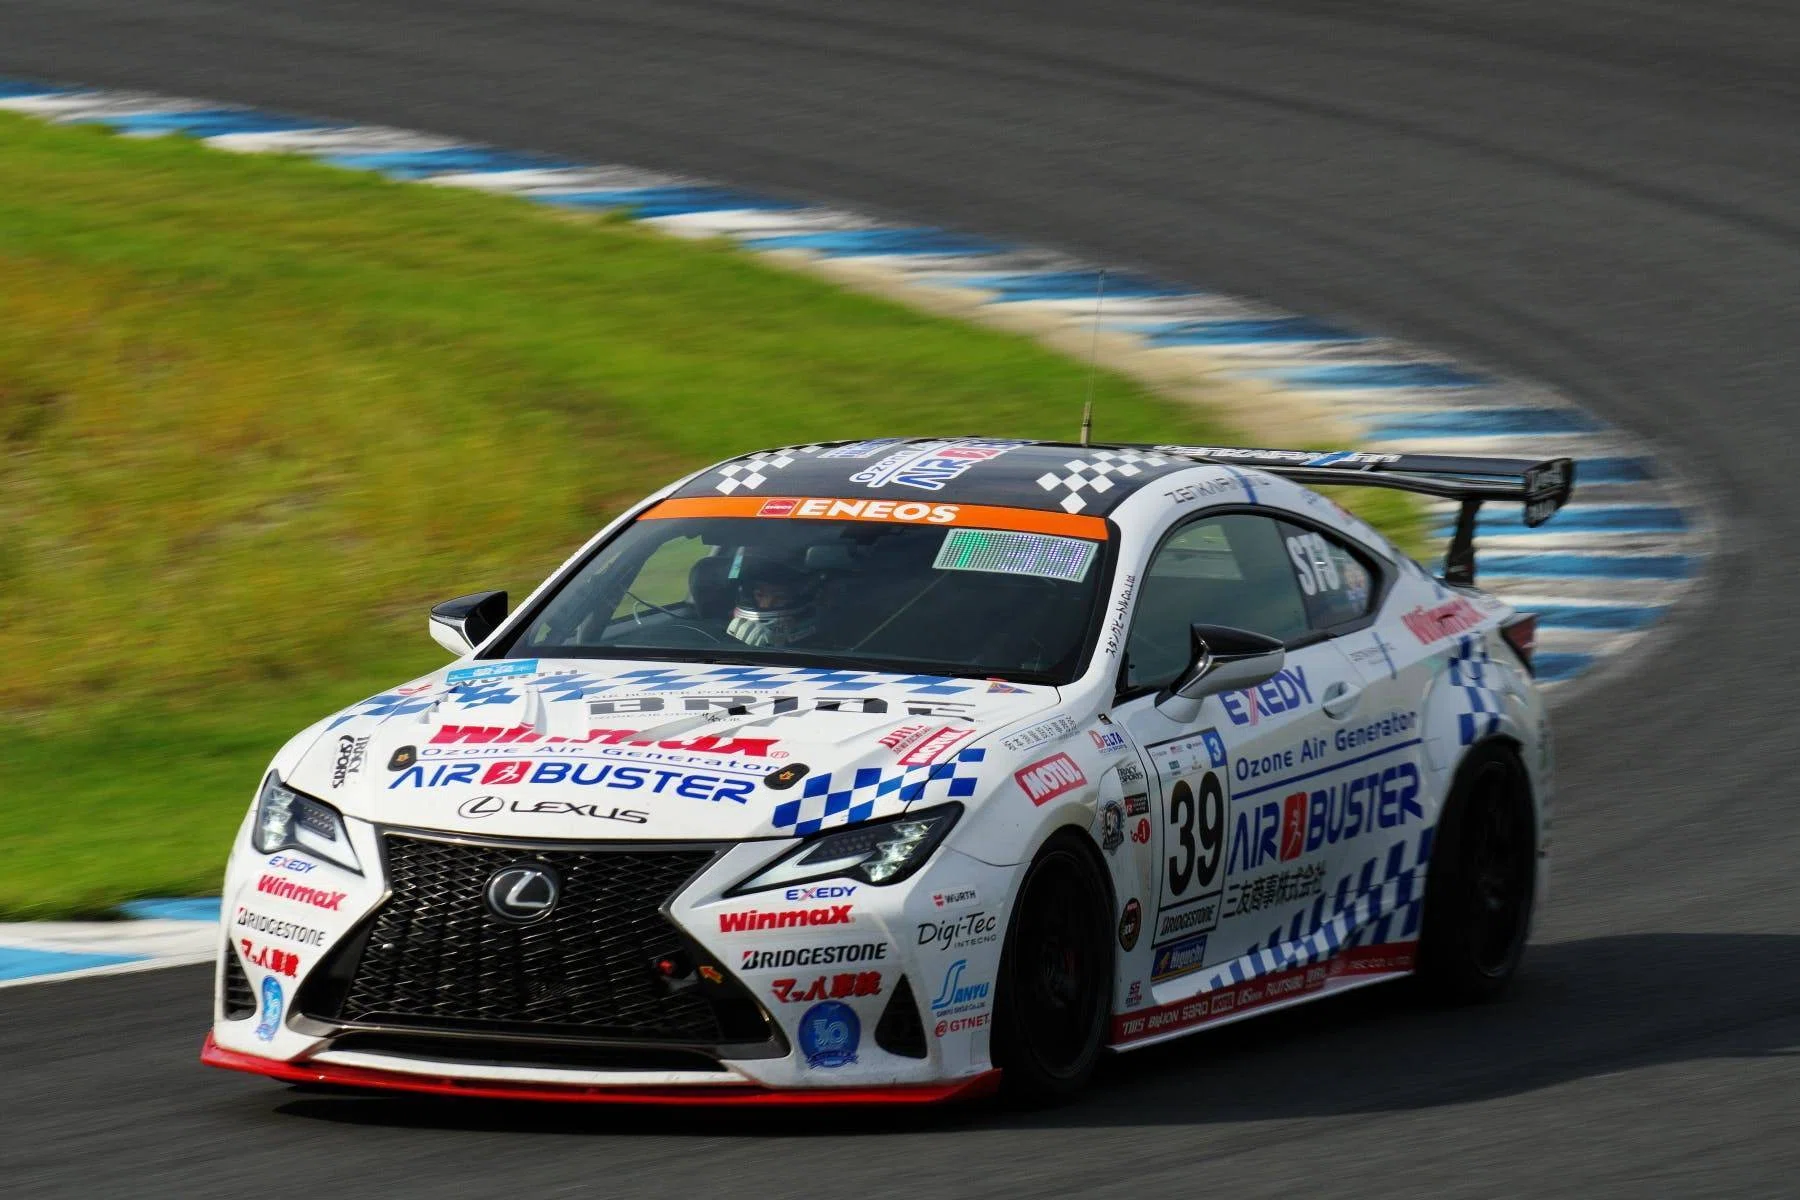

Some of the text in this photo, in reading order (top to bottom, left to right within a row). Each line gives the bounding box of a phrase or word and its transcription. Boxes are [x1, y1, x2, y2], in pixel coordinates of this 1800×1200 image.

[796, 499, 960, 524] ENEOS
[1217, 665, 1313, 726] EXEDY
[421, 746, 780, 775] Ozone Air Generator
[1235, 750, 1294, 782] Ozone
[1300, 738, 1328, 764] Air
[1334, 710, 1417, 753] Generator
[388, 762, 756, 805] AIR BUSTER
[1021, 756, 1082, 801] MOTUL
[510, 800, 649, 824] LEXUS
[1227, 761, 1424, 876] AIR BUSTER
[1169, 770, 1225, 896] 39
[268, 855, 317, 875] EXEDY
[785, 885, 858, 901] EXEDY
[237, 906, 326, 948] BRIDGESTONE
[917, 911, 996, 951] Digi-Tec
[1159, 903, 1216, 937] BRIDGESTONE
[741, 942, 888, 971] BRIDGESTONE
[954, 933, 997, 949] INTECNO
[931, 959, 991, 1010] SANYU
[950, 1013, 990, 1032] GTNET
